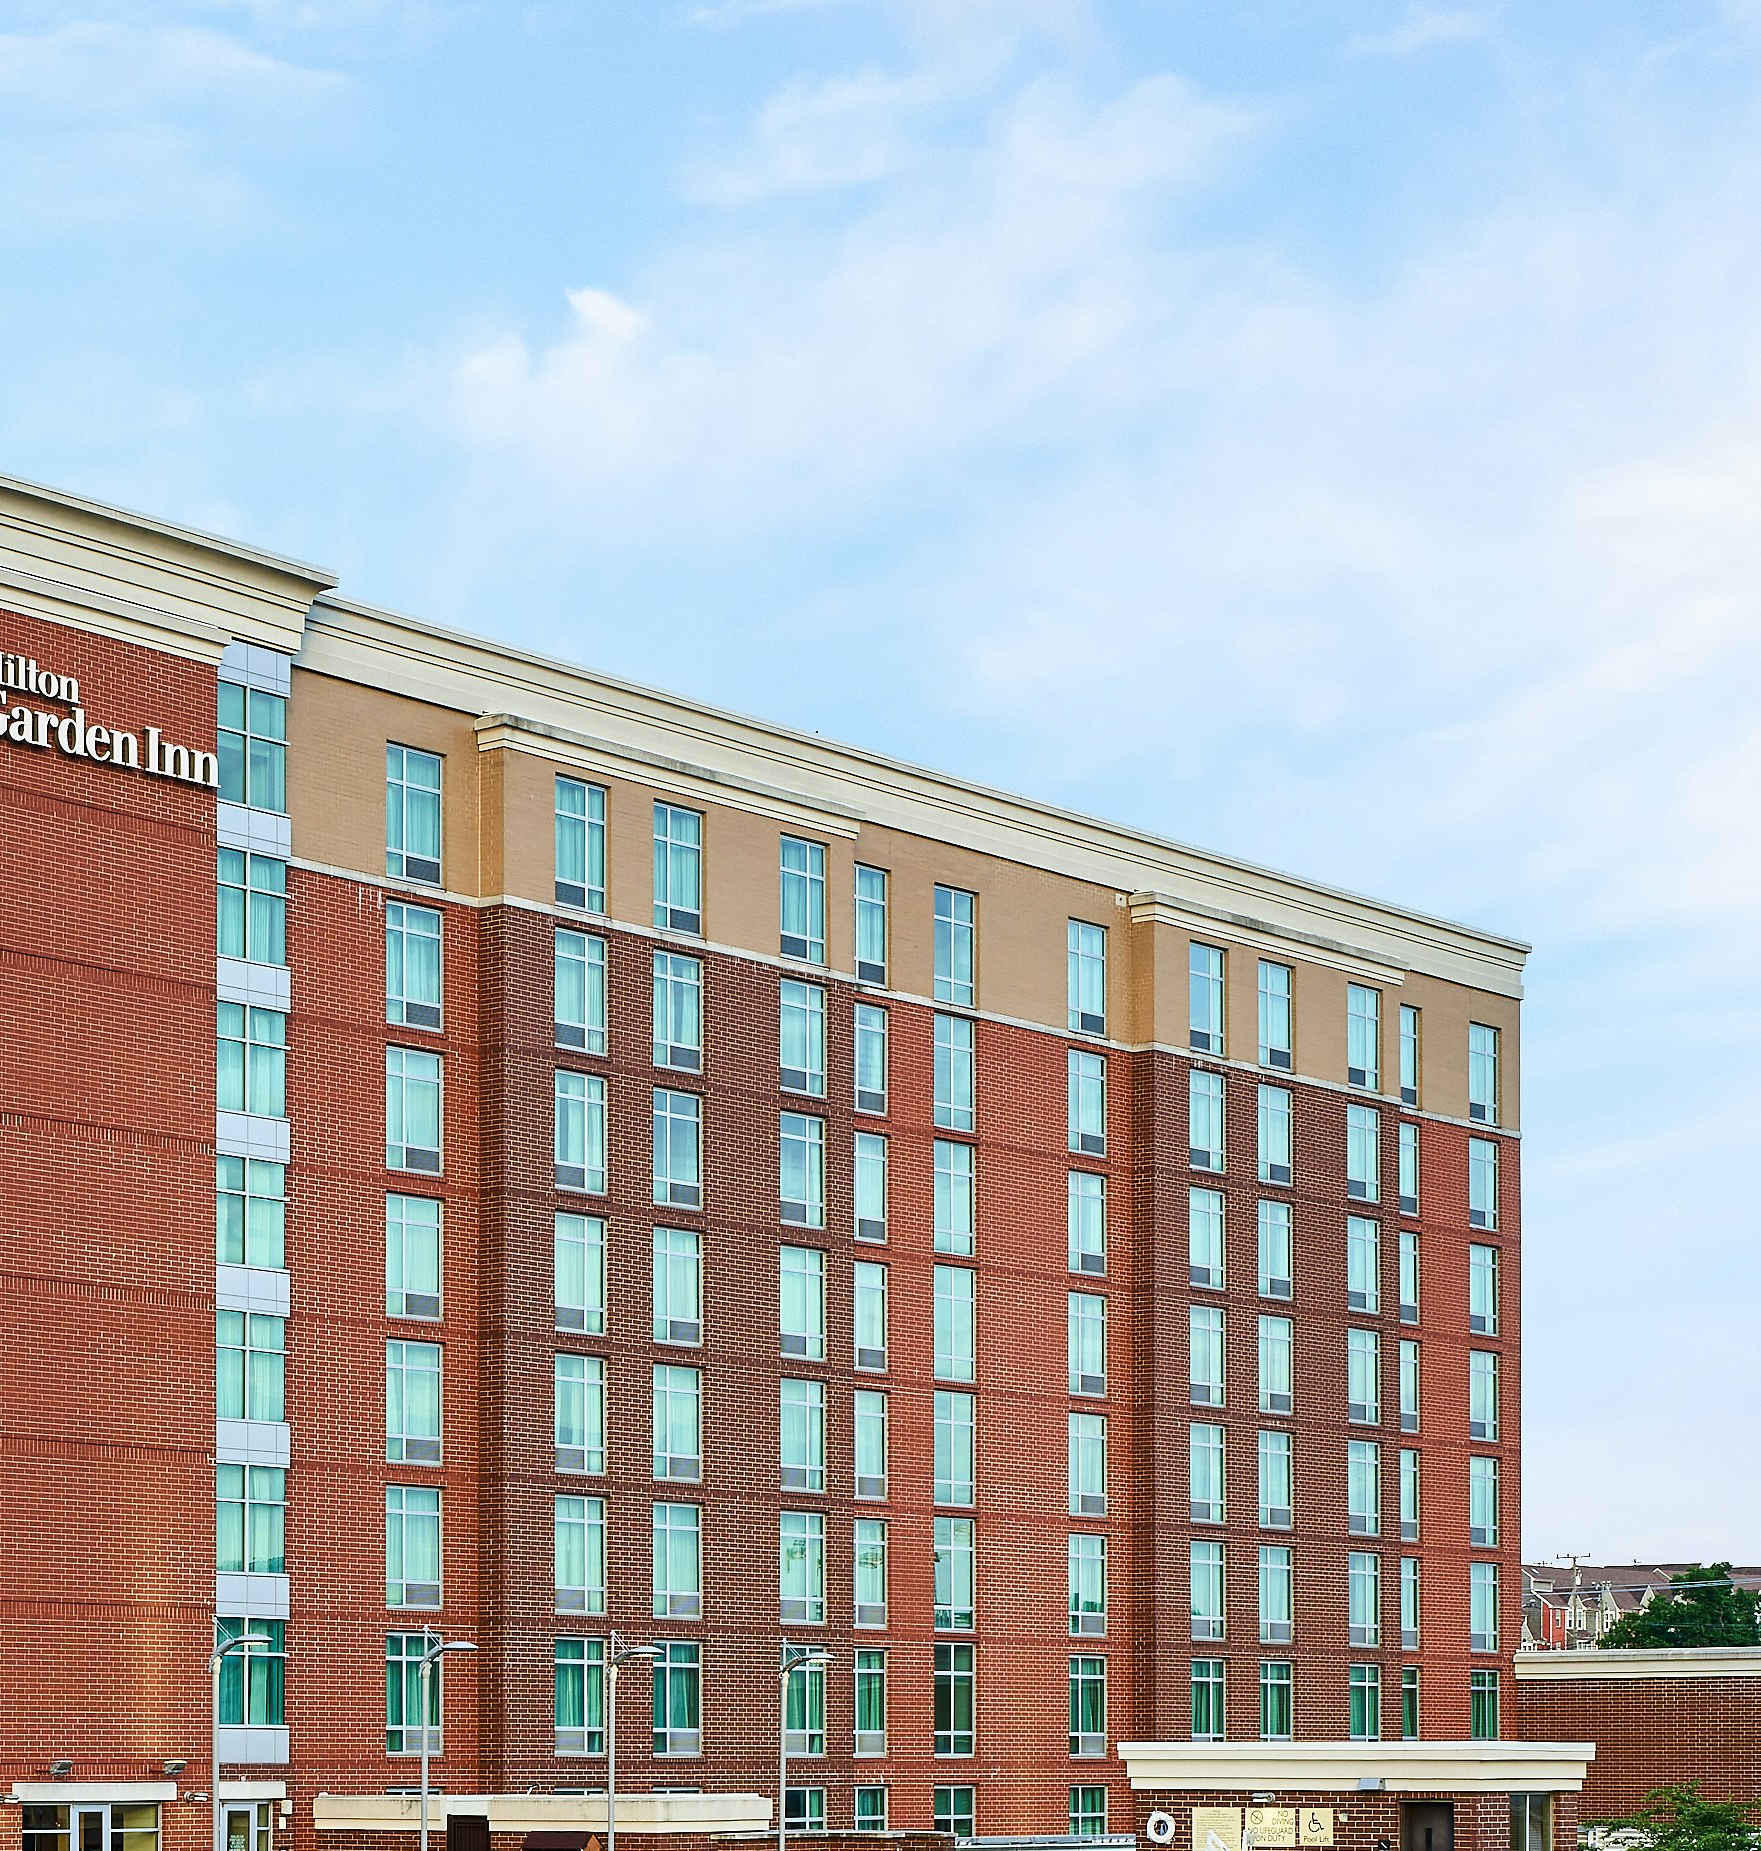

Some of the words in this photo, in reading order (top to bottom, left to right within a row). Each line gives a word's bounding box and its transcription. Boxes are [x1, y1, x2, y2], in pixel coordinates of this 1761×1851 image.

[144, 726, 222, 789] Inn
[1272, 1818, 1294, 1826] DIVING
[1260, 1827, 1294, 1835] LIFEGUARD
